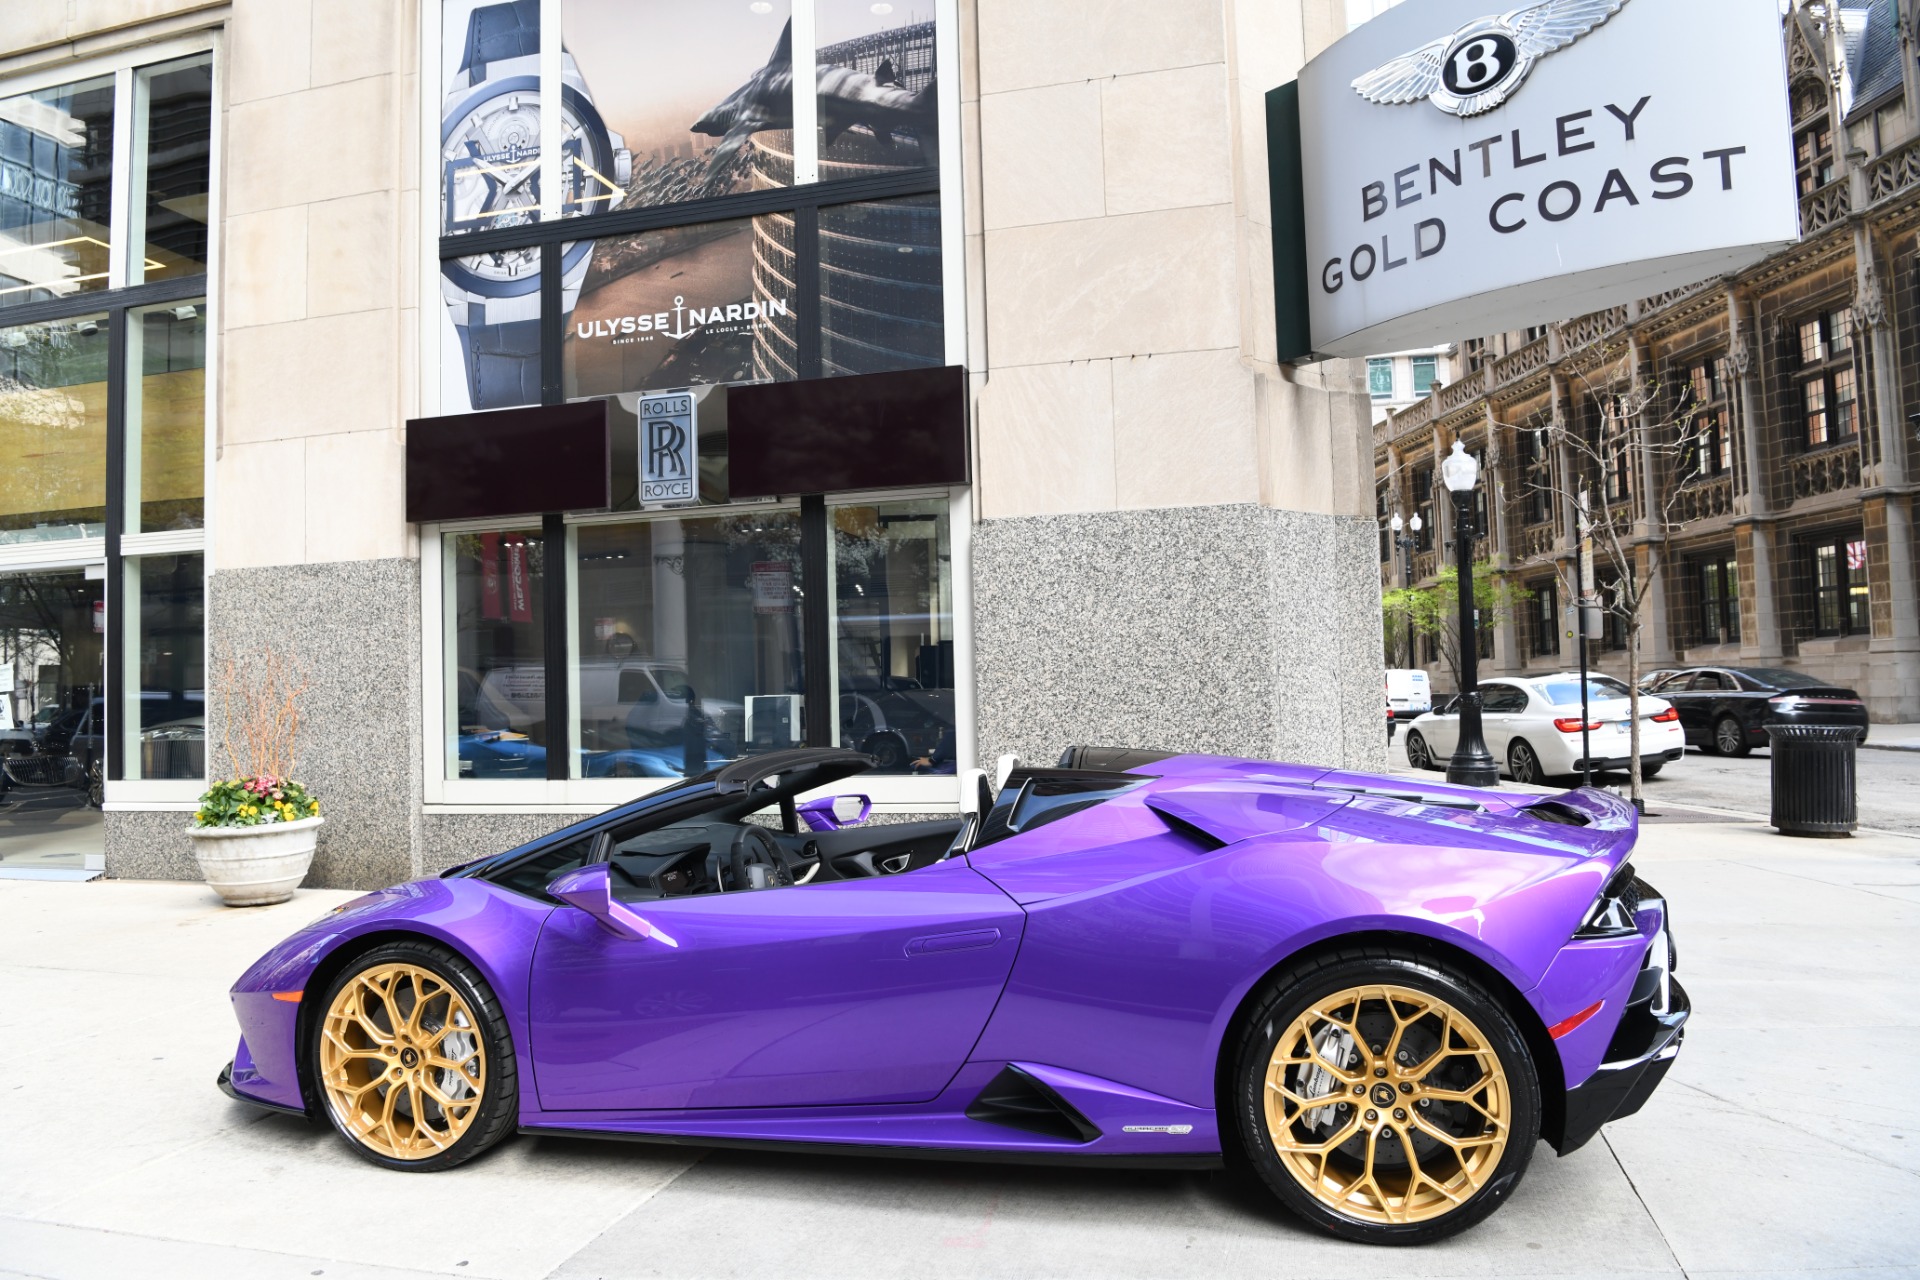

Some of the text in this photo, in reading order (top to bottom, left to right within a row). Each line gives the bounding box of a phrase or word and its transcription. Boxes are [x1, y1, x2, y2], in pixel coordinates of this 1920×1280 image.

[483, 148, 540, 162] ULYSSE NARD
[1362, 95, 1651, 223] BENTLEY
[1322, 145, 1747, 294] GOLD COAST
[577, 299, 787, 339] ULYSSE NARDIN
[716, 325, 738, 333] LOCLE
[644, 400, 688, 415] ROLLS
[645, 482, 689, 497] ROYCE
